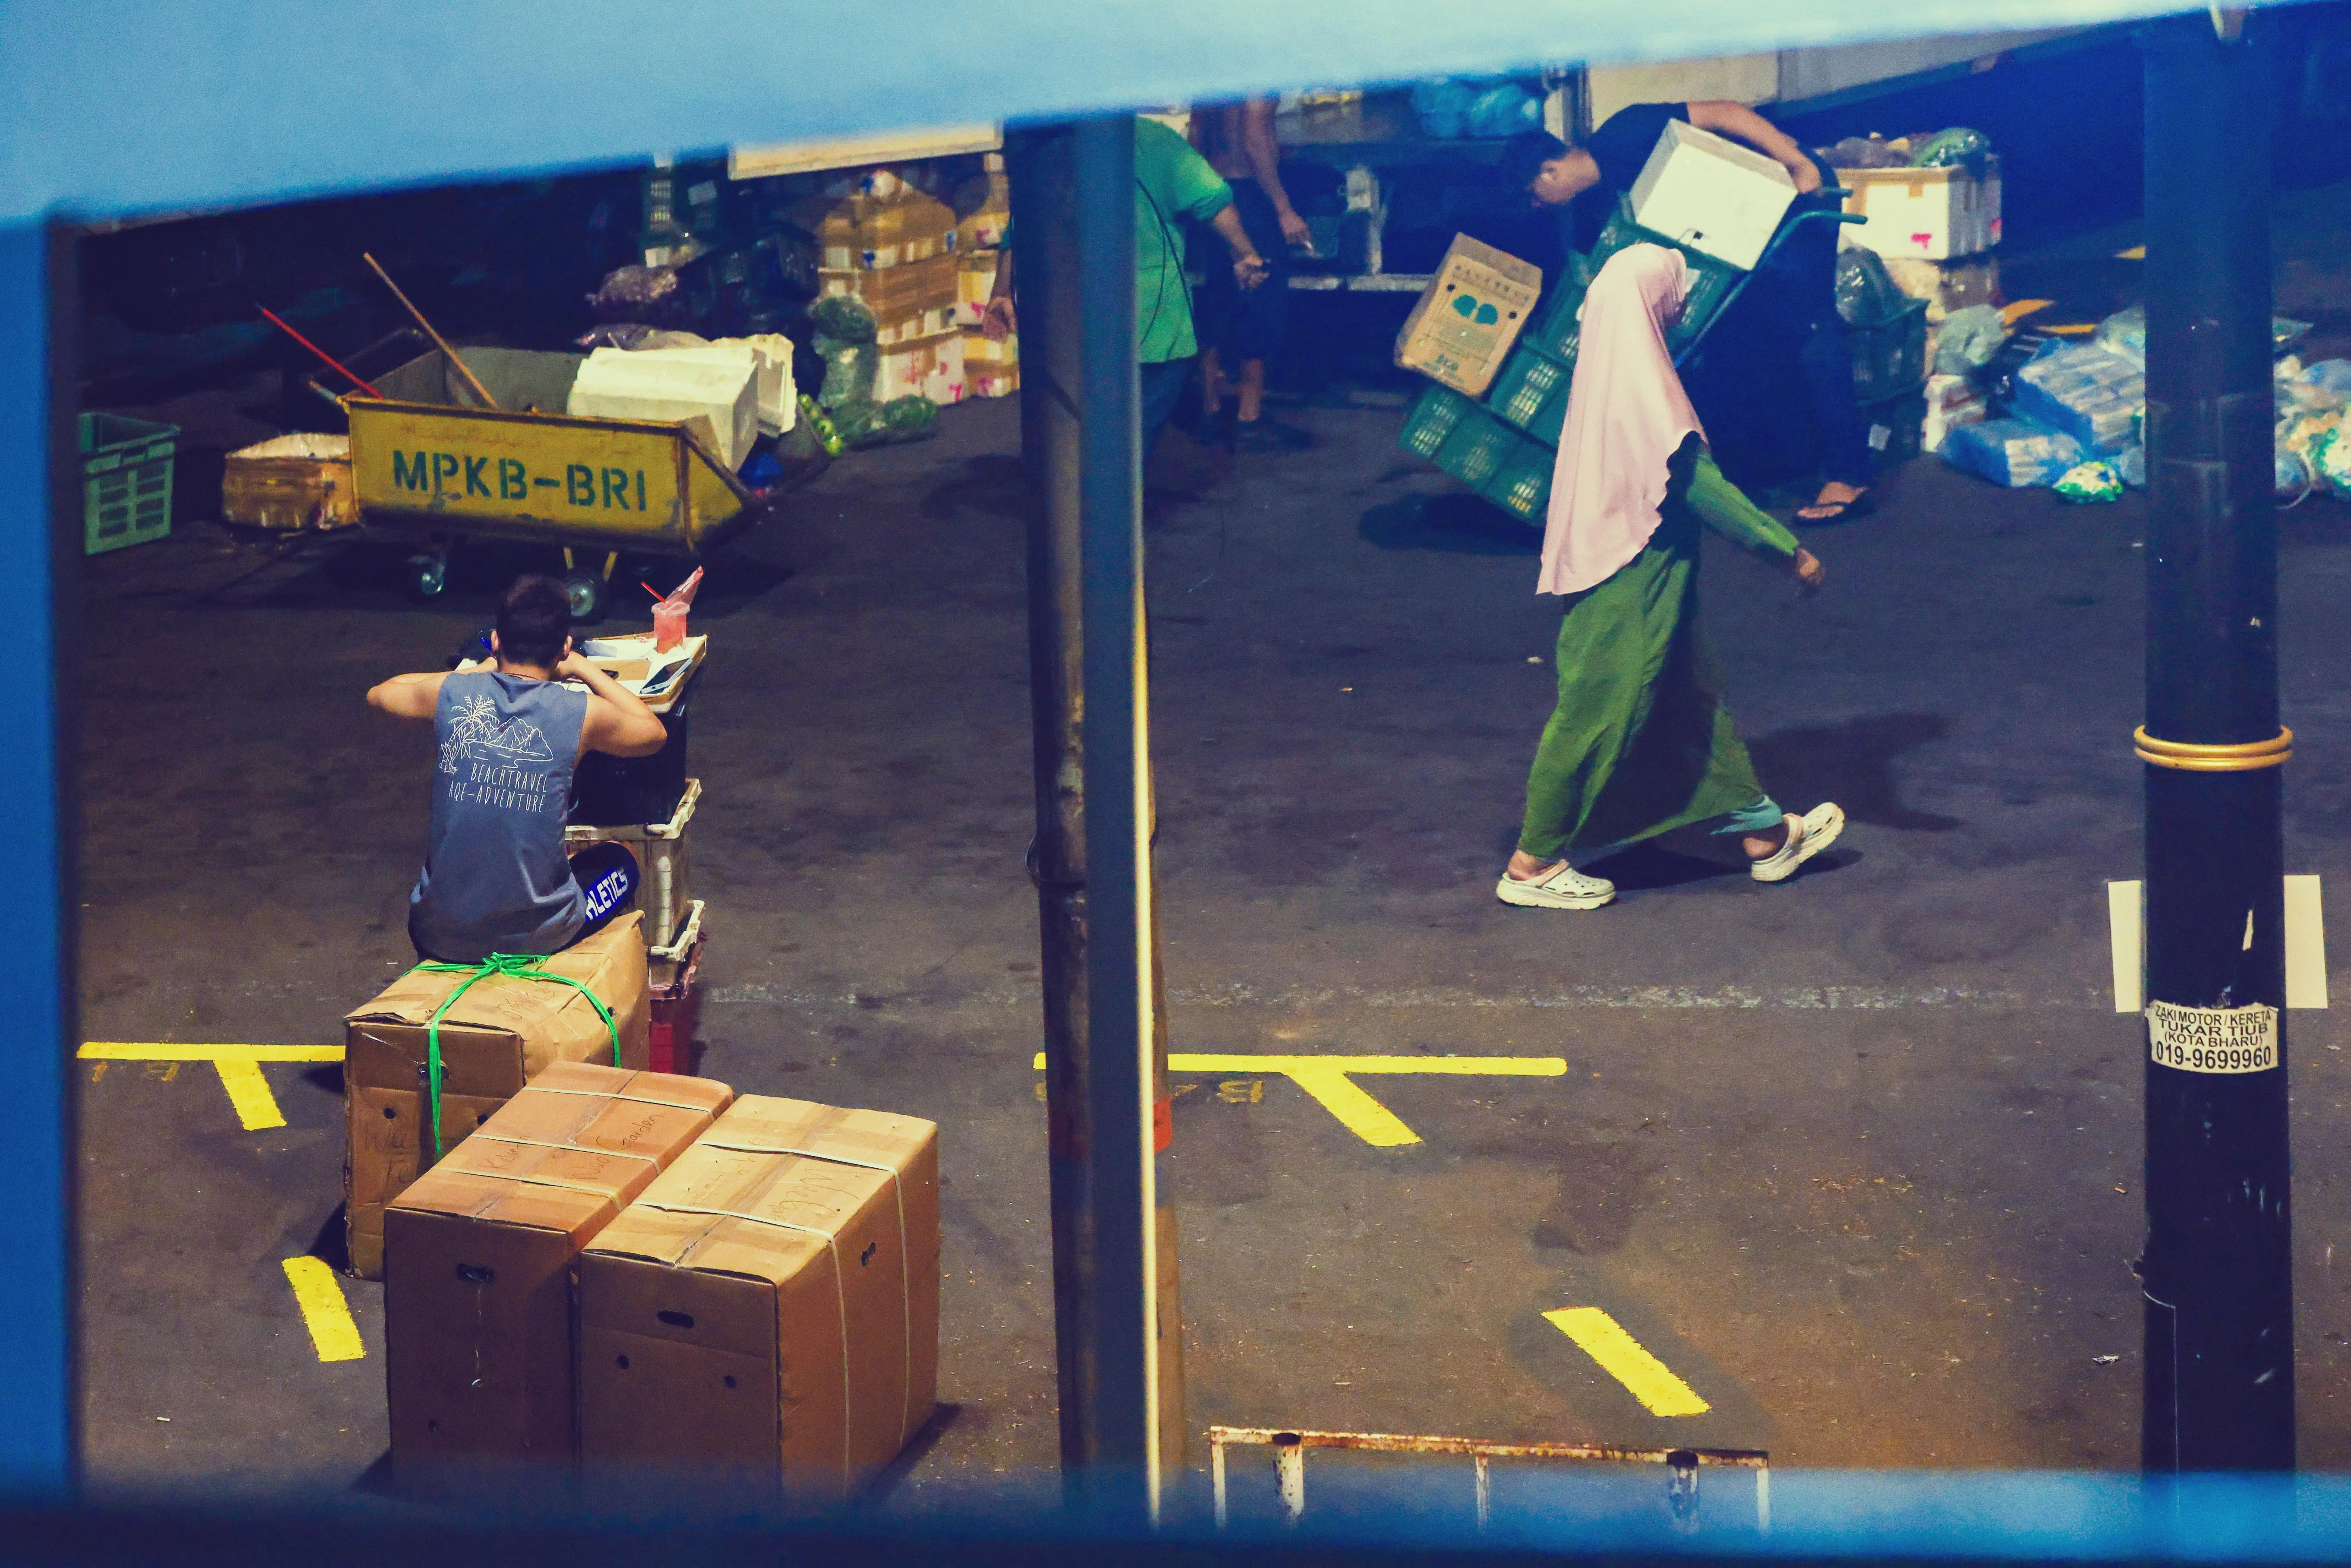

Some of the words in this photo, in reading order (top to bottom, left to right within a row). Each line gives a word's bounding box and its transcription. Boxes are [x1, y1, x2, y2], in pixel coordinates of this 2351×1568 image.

[393, 449, 646, 511] MPKB-BRI
[2159, 1018, 2222, 1036] TUKAR
[2227, 1023, 2268, 1037] TIUB
[2179, 1011, 2222, 1026] MOTOR
[2231, 1010, 2272, 1025] KERETA
[2164, 1031, 2205, 1047] (KOTA
[2208, 1035, 2263, 1047] BHARU)
[2156, 1040, 2272, 1069] 019-9699960
